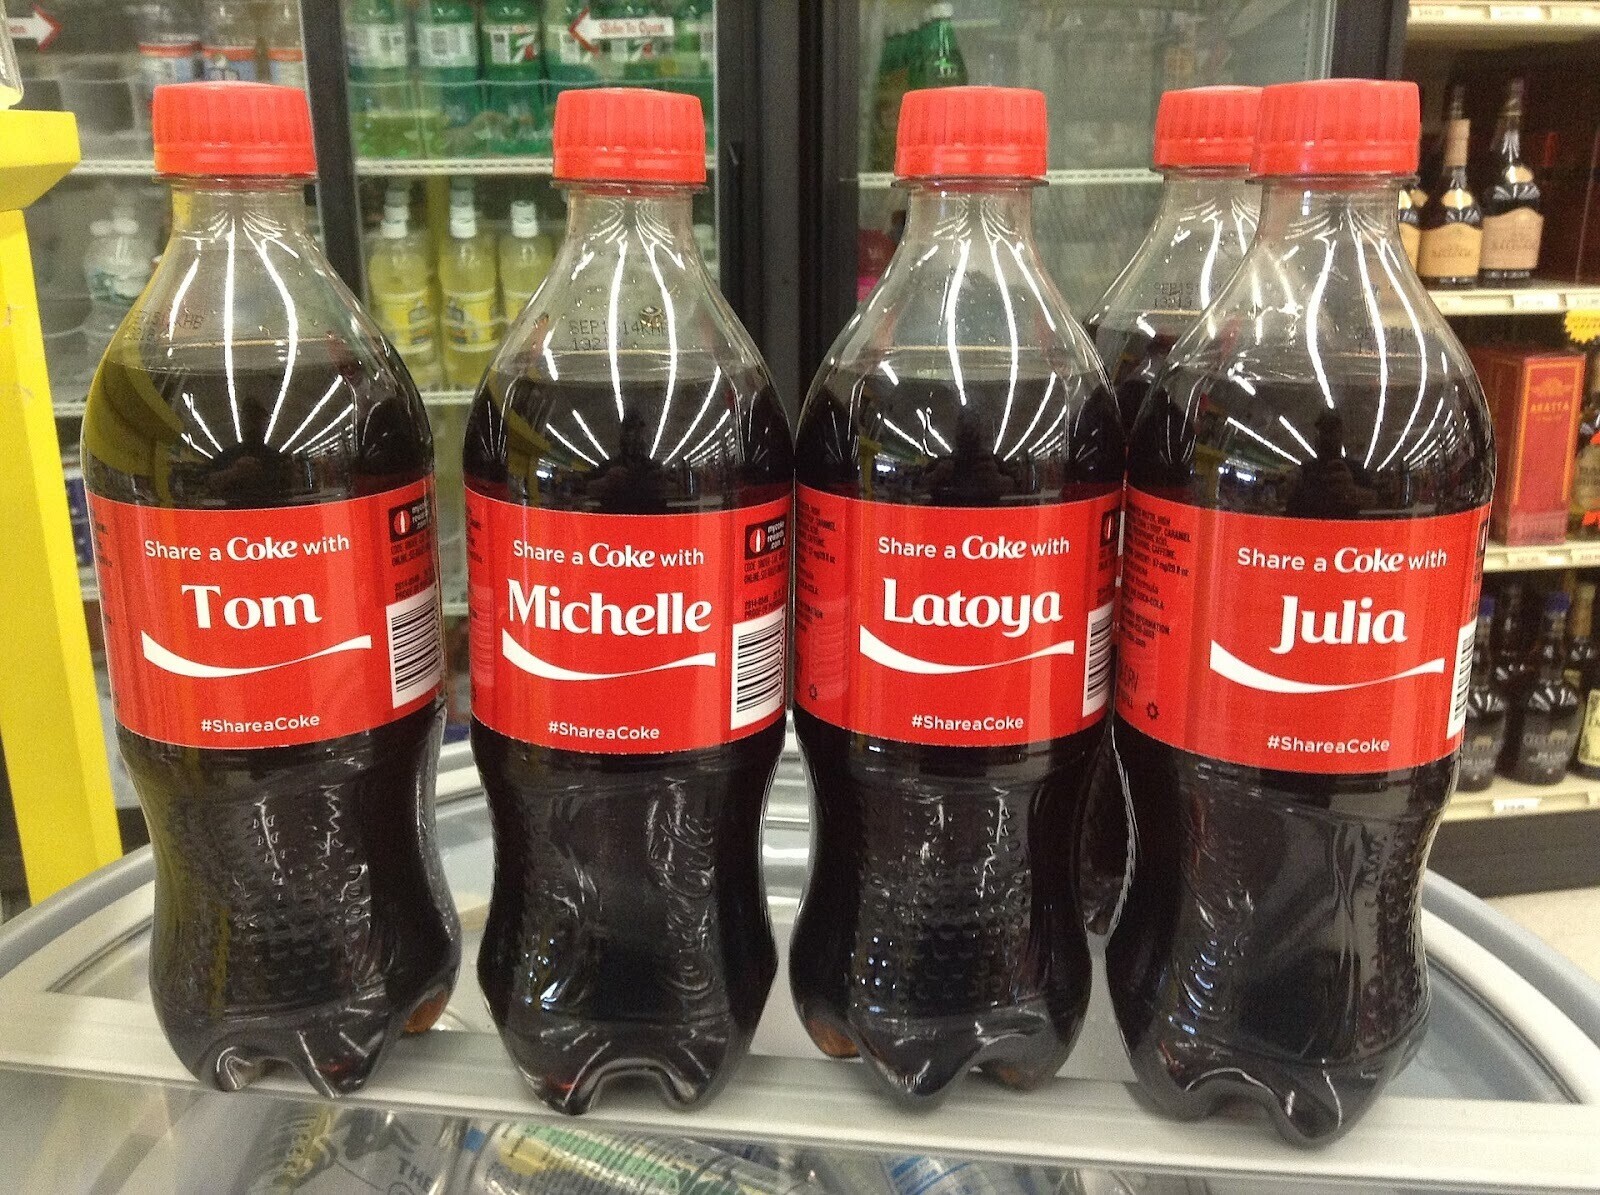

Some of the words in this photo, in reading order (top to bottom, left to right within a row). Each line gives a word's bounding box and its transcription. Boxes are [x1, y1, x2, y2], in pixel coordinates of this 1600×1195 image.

[144, 540, 202, 561] Share
[209, 548, 222, 561] a
[226, 536, 298, 561] Coke
[303, 533, 350, 557] with
[513, 538, 566, 565] Share
[572, 551, 584, 566] a
[588, 542, 655, 569] Coke
[660, 547, 705, 568] with
[878, 536, 937, 559] Share
[943, 545, 956, 559] a
[961, 534, 1028, 561] Coke
[1030, 537, 1070, 557] with
[1237, 546, 1306, 572] Share
[1313, 556, 1327, 573] a
[1333, 546, 1405, 574] Coke
[1408, 548, 1448, 570] with
[180, 583, 323, 631] Tom
[506, 577, 713, 637] Michelle
[882, 577, 1064, 639] Latoya
[1268, 595, 1409, 655] Julia
[200, 714, 321, 734] #ShareaCoke
[547, 720, 661, 741] #ShareaCoke
[911, 714, 1024, 732] #ShareaCoke
[1266, 734, 1391, 755] #ShareaCoke
